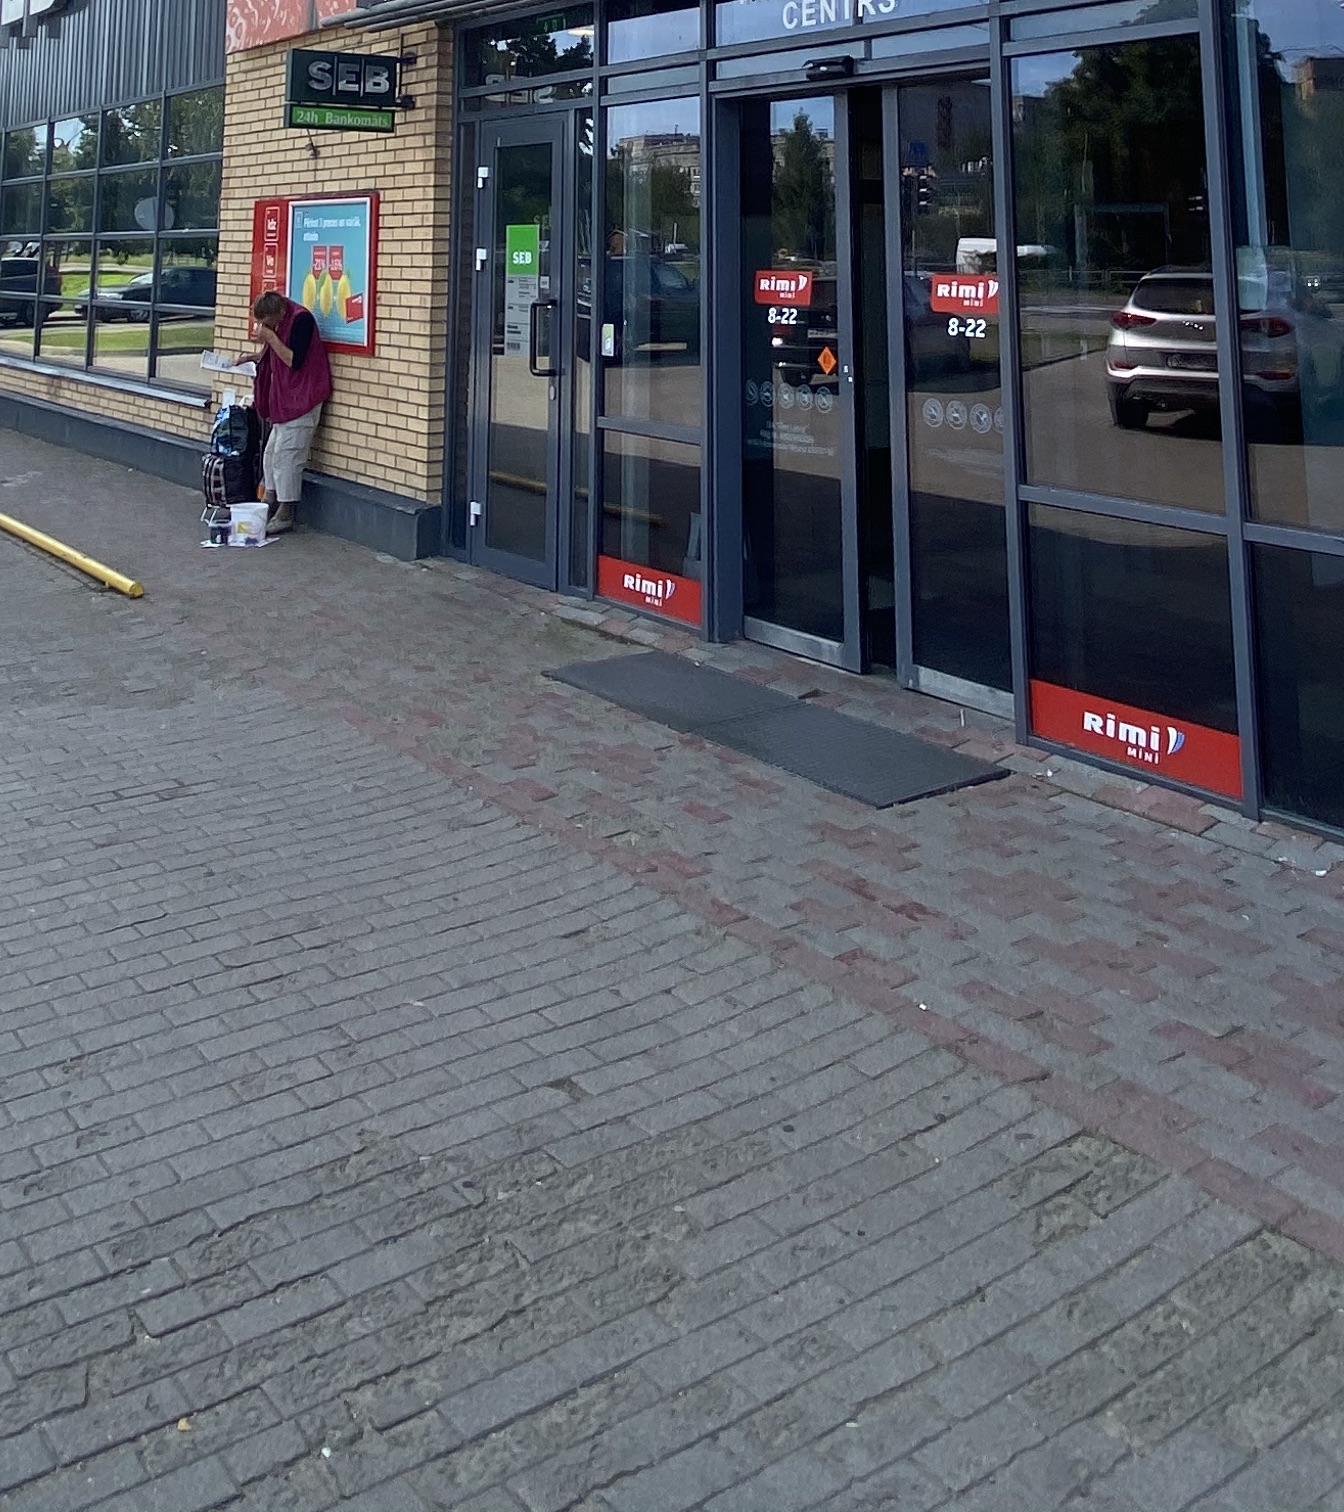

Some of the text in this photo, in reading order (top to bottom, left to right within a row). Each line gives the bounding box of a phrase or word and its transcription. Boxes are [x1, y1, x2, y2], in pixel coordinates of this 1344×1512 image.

[308, 60, 390, 94] SEB
[296, 110, 390, 127] 24h Bankomats
[512, 251, 532, 264] SEB
[937, 280, 985, 299] Rimi
[767, 307, 798, 324] 8-22
[947, 317, 987, 338] 8-22
[1083, 711, 1160, 751] Rimi
